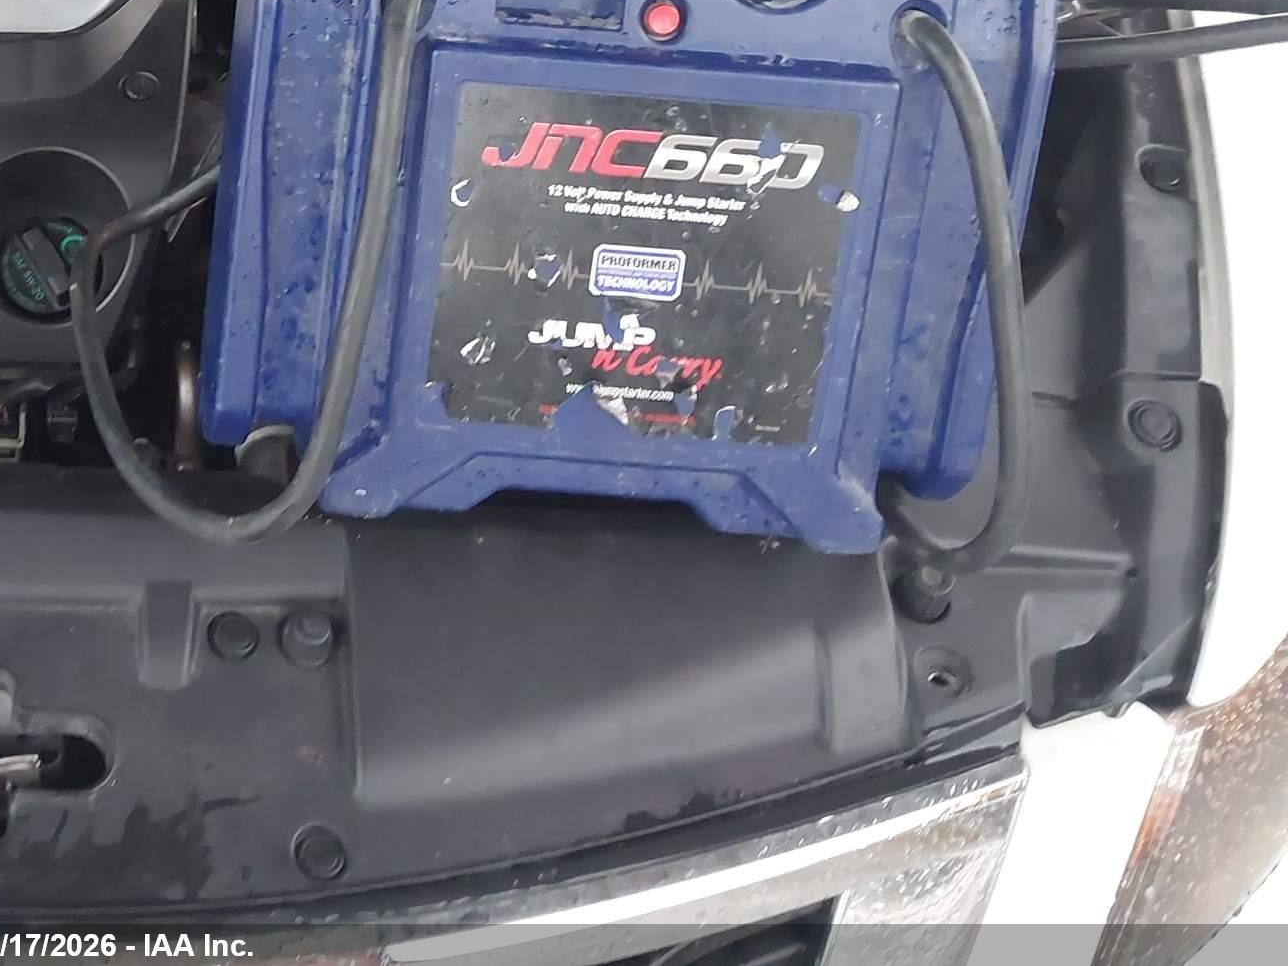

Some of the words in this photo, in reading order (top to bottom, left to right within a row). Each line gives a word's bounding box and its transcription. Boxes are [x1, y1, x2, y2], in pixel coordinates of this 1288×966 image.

[548, 184, 564, 197] 12
[586, 186, 624, 201] Power
[624, 190, 663, 206] Supply
[663, 193, 673, 206] &
[674, 194, 707, 210] Jump
[707, 196, 746, 211] Starter
[591, 202, 621, 217] AUTO
[621, 205, 666, 220] CHARGE
[667, 208, 729, 227] Technology
[601, 256, 677, 271] PROFORMER
[596, 275, 676, 292] TECHNOLOGY
[528, 314, 657, 351] JUMP
